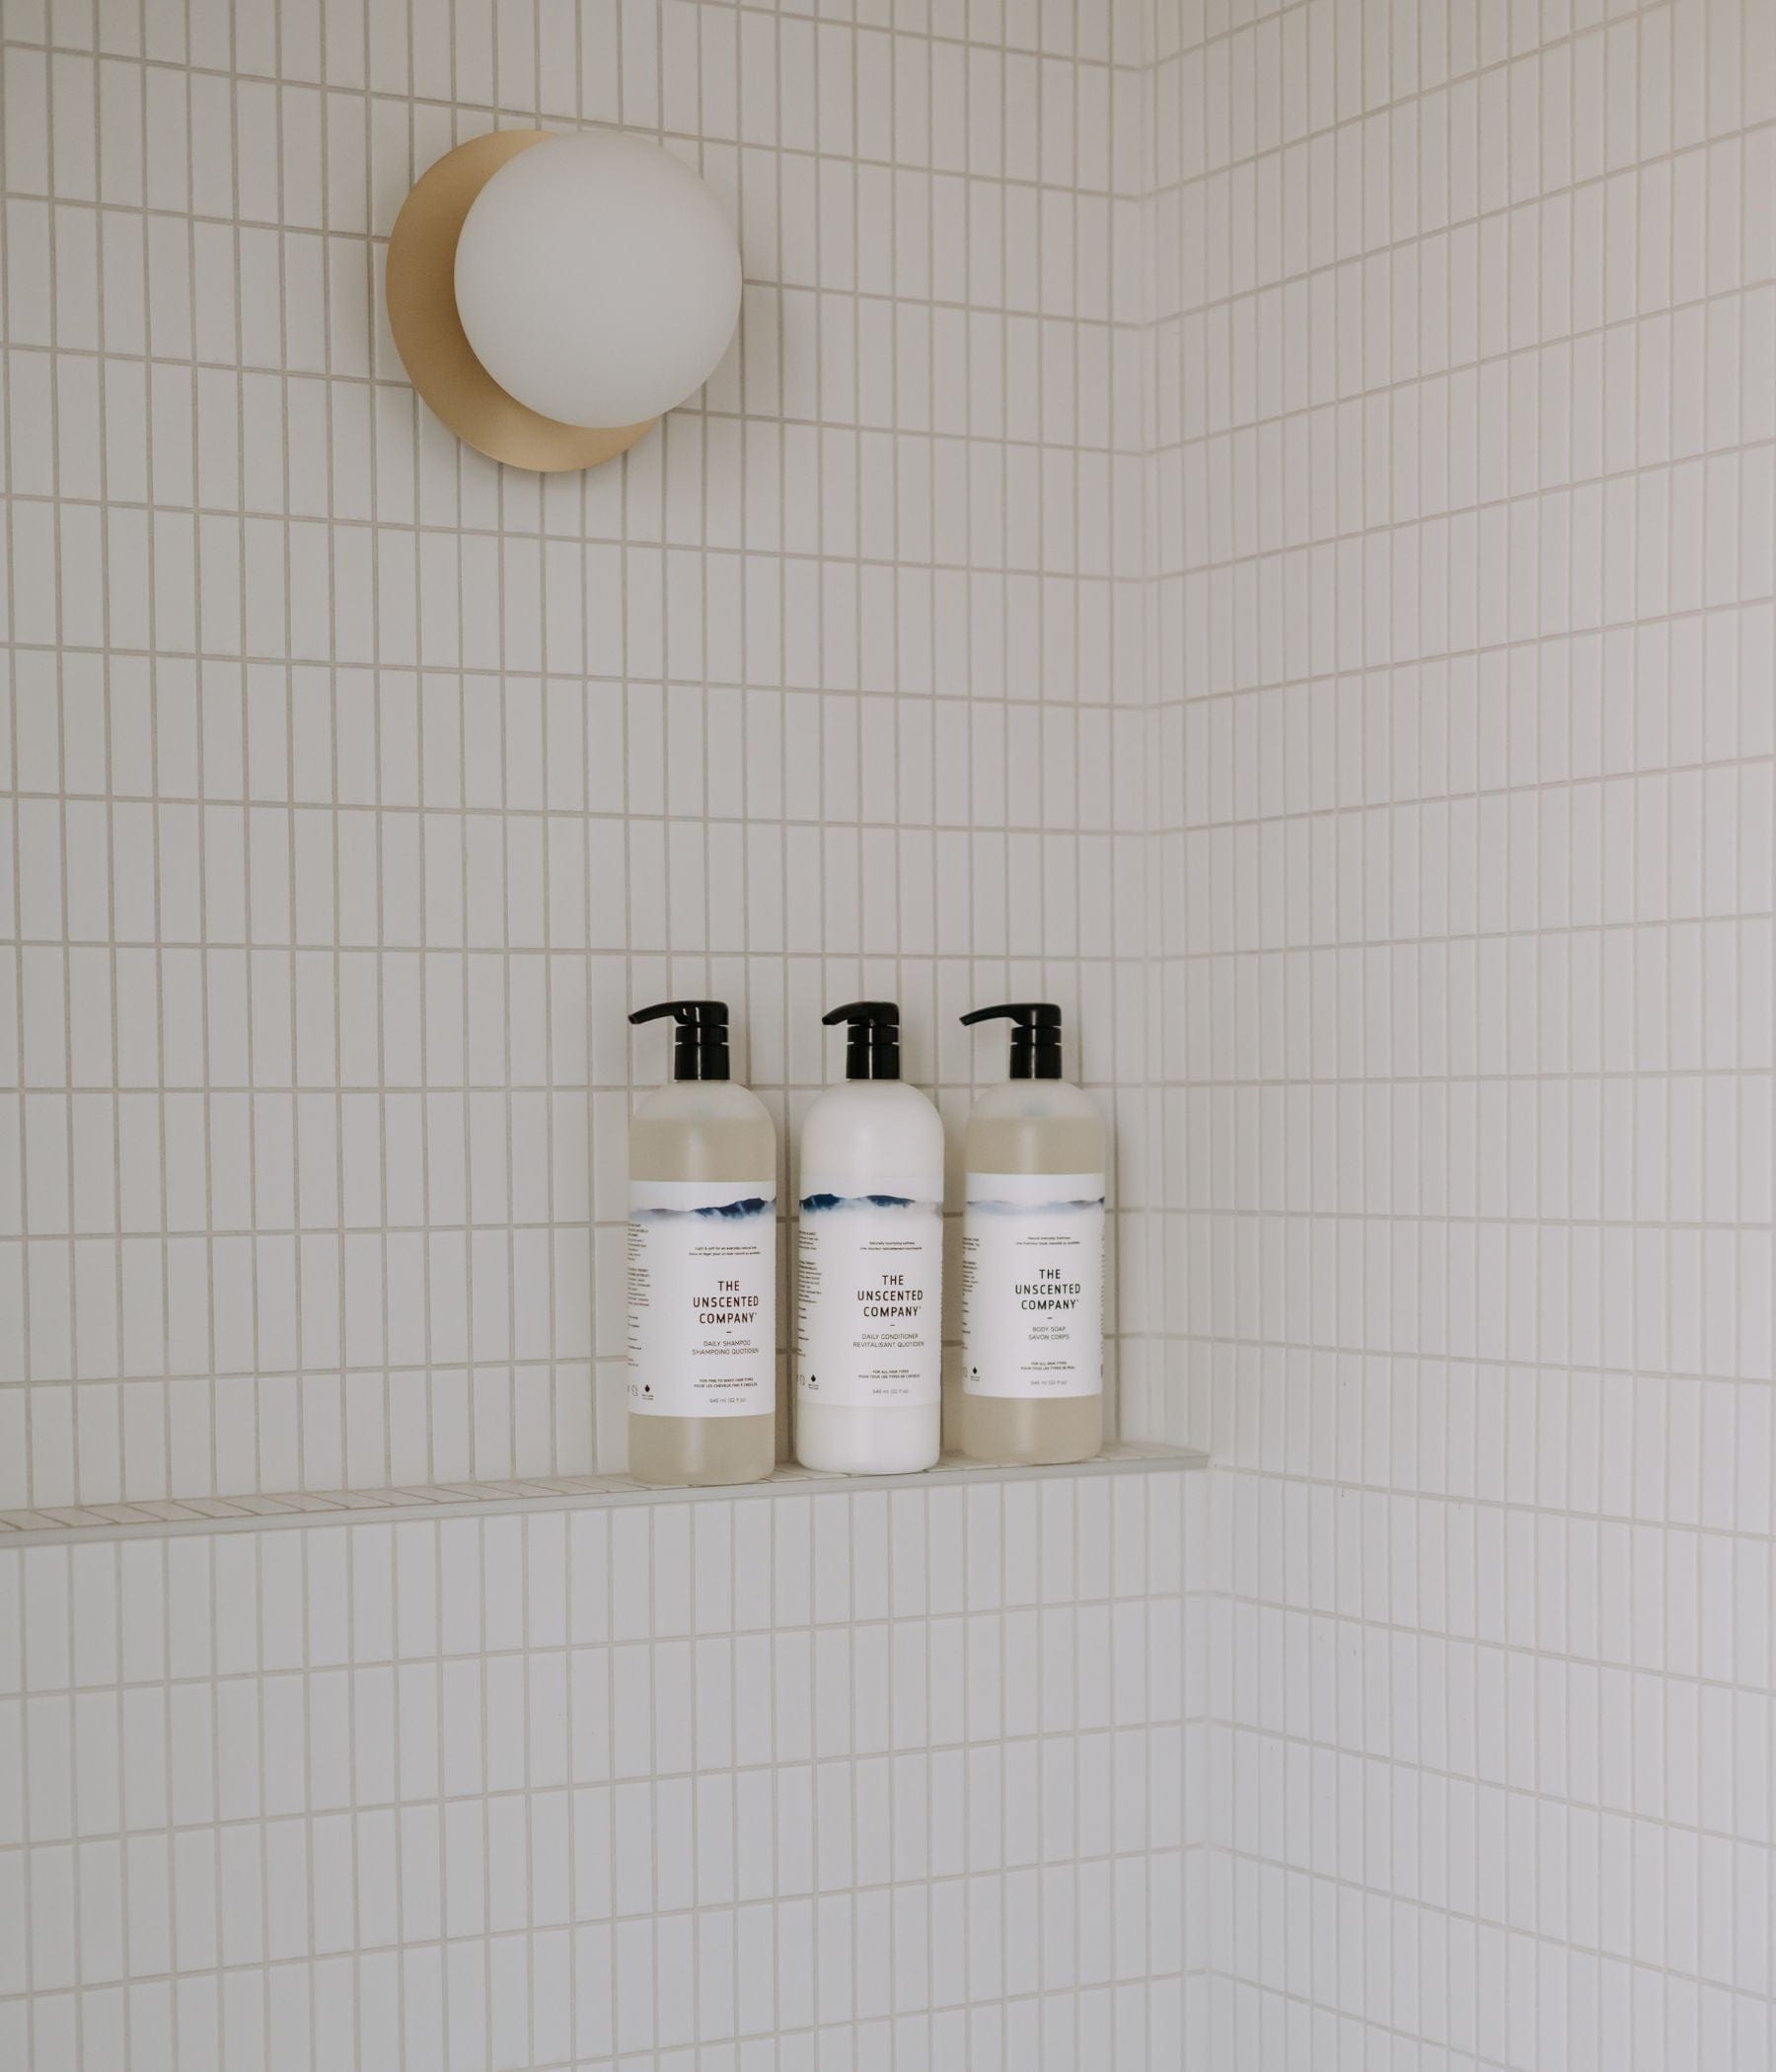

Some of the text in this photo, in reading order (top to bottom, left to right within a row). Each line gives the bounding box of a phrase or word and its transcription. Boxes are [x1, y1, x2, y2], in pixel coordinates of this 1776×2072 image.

[1039, 1269, 1061, 1280] THE
[882, 1275, 905, 1286] THE
[717, 1281, 740, 1292] THE
[1014, 1284, 1081, 1295] UNSCENTED
[857, 1290, 924, 1301] UNSCENTED
[693, 1295, 759, 1308] UNSCENTED
[1021, 1298, 1076, 1310] COMPANY
[863, 1305, 919, 1317] COMPANY
[699, 1312, 755, 1324] COMPANY
